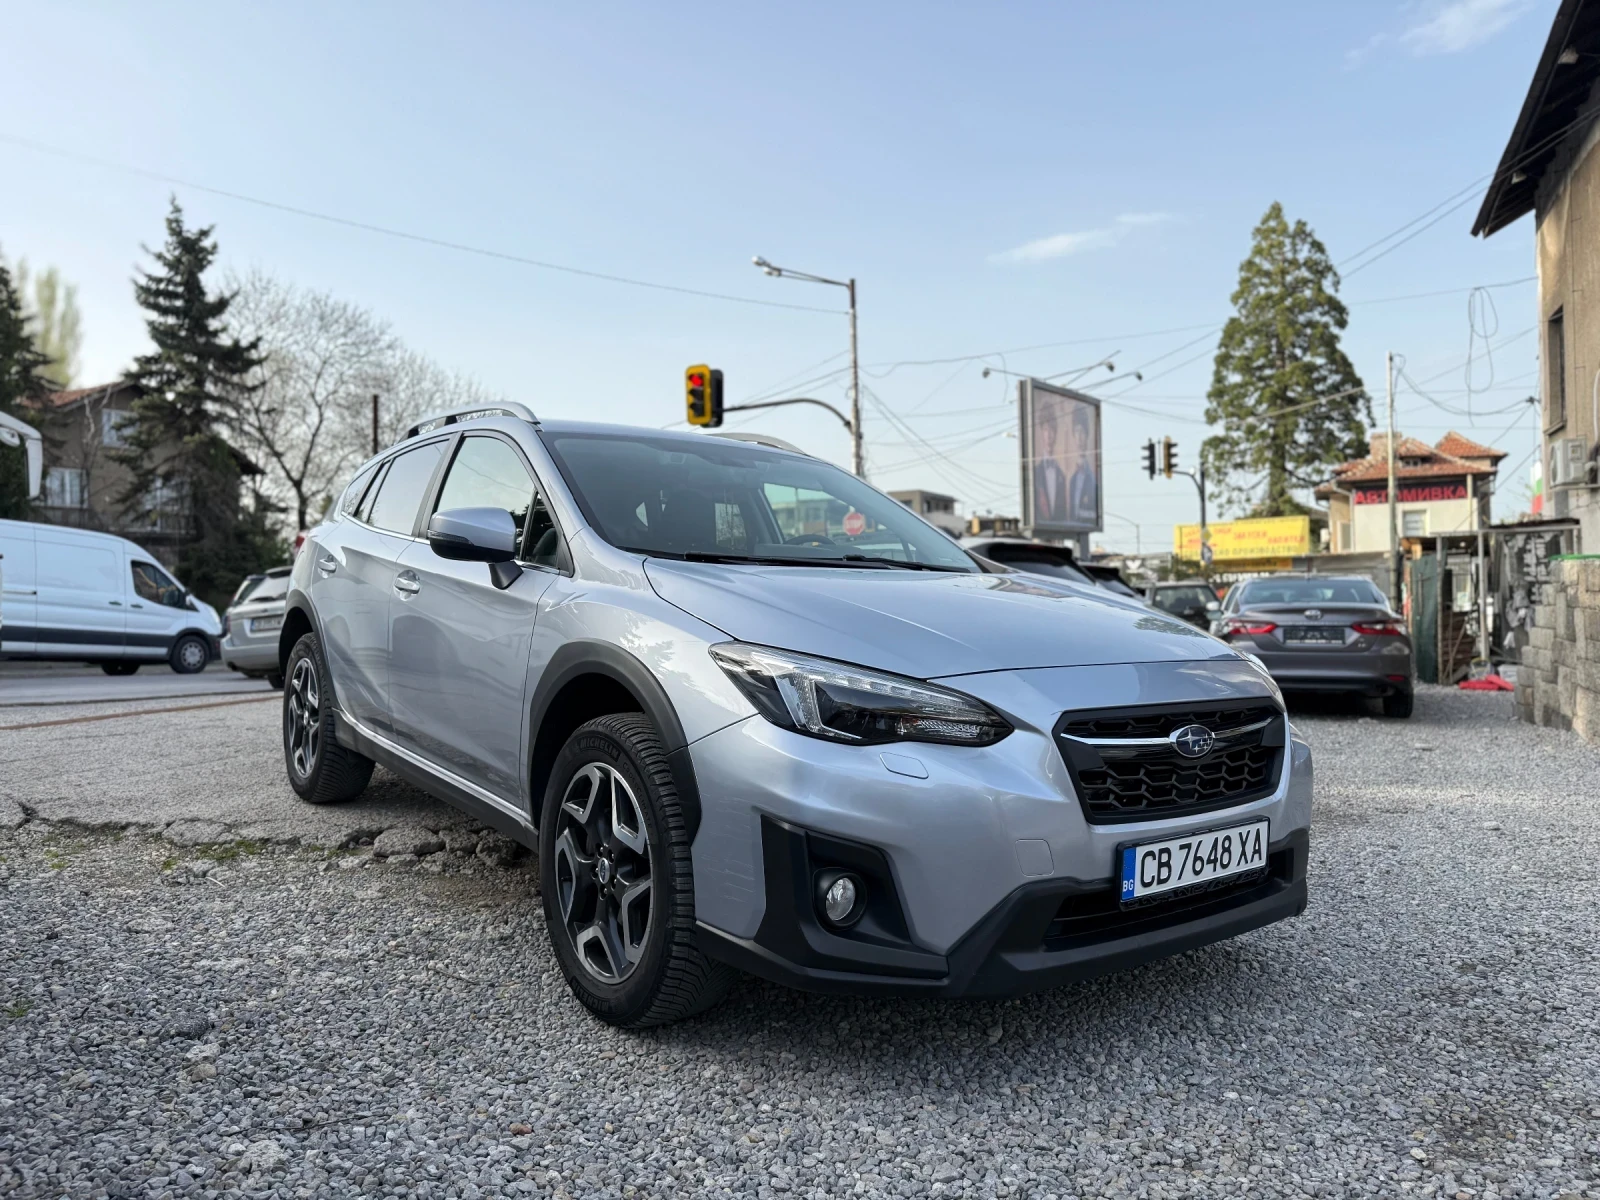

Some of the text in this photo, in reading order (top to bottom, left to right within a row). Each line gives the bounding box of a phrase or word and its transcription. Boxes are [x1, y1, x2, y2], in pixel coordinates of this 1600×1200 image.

[580, 737, 620, 760] MICHELIN
[1140, 847, 1172, 888] CB
[1177, 835, 1232, 881] 7648
[1236, 828, 1262, 867] XA
[1122, 879, 1134, 892] BG
